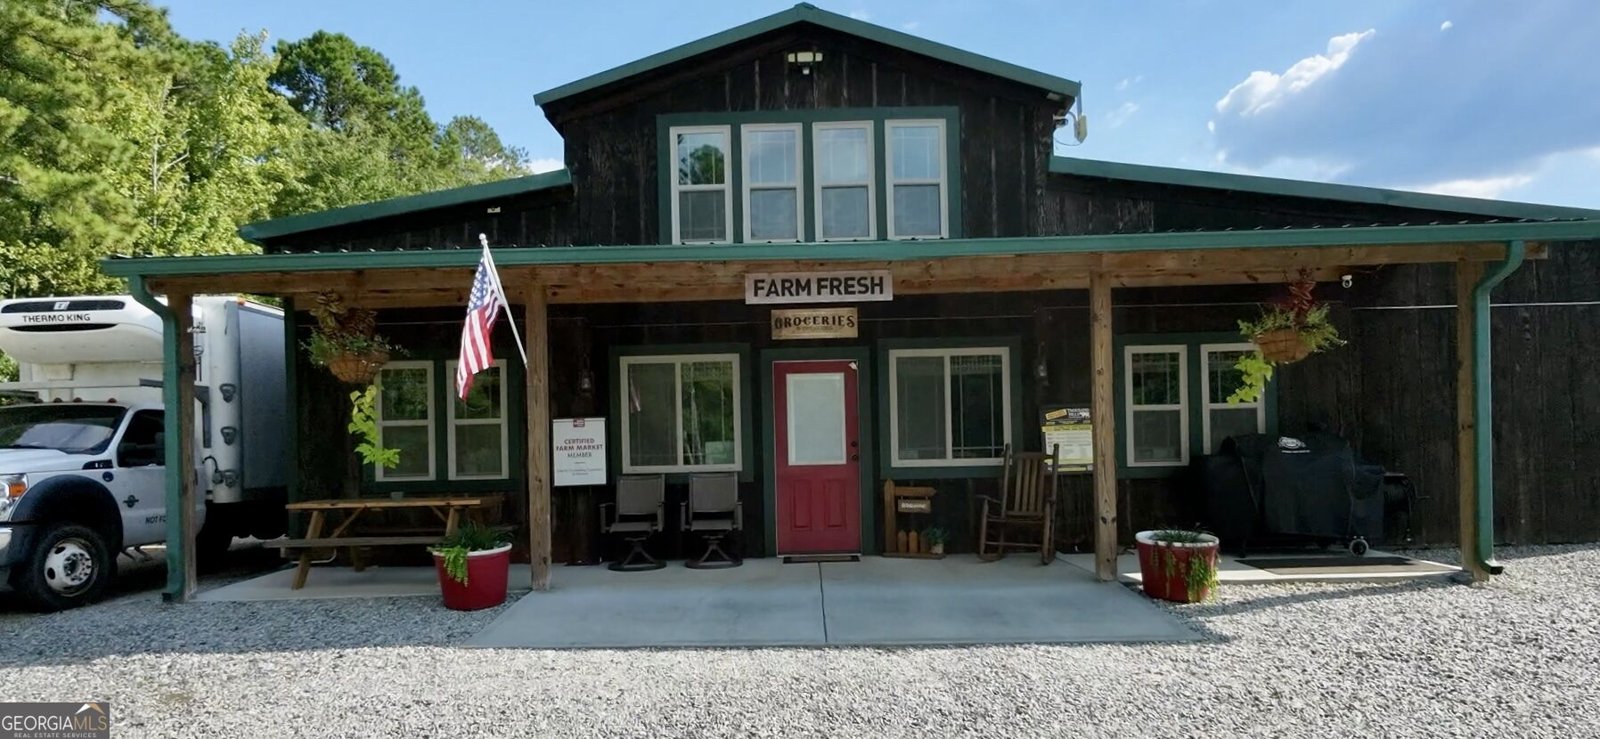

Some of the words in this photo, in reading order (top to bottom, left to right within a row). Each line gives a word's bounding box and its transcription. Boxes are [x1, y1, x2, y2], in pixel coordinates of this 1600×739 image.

[753, 278, 812, 297] FARM
[816, 276, 884, 295] FRESH
[23, 314, 65, 323] THERMO
[66, 313, 91, 322] KING
[774, 315, 855, 330] GROCERIES
[145, 516, 158, 524] NOT
